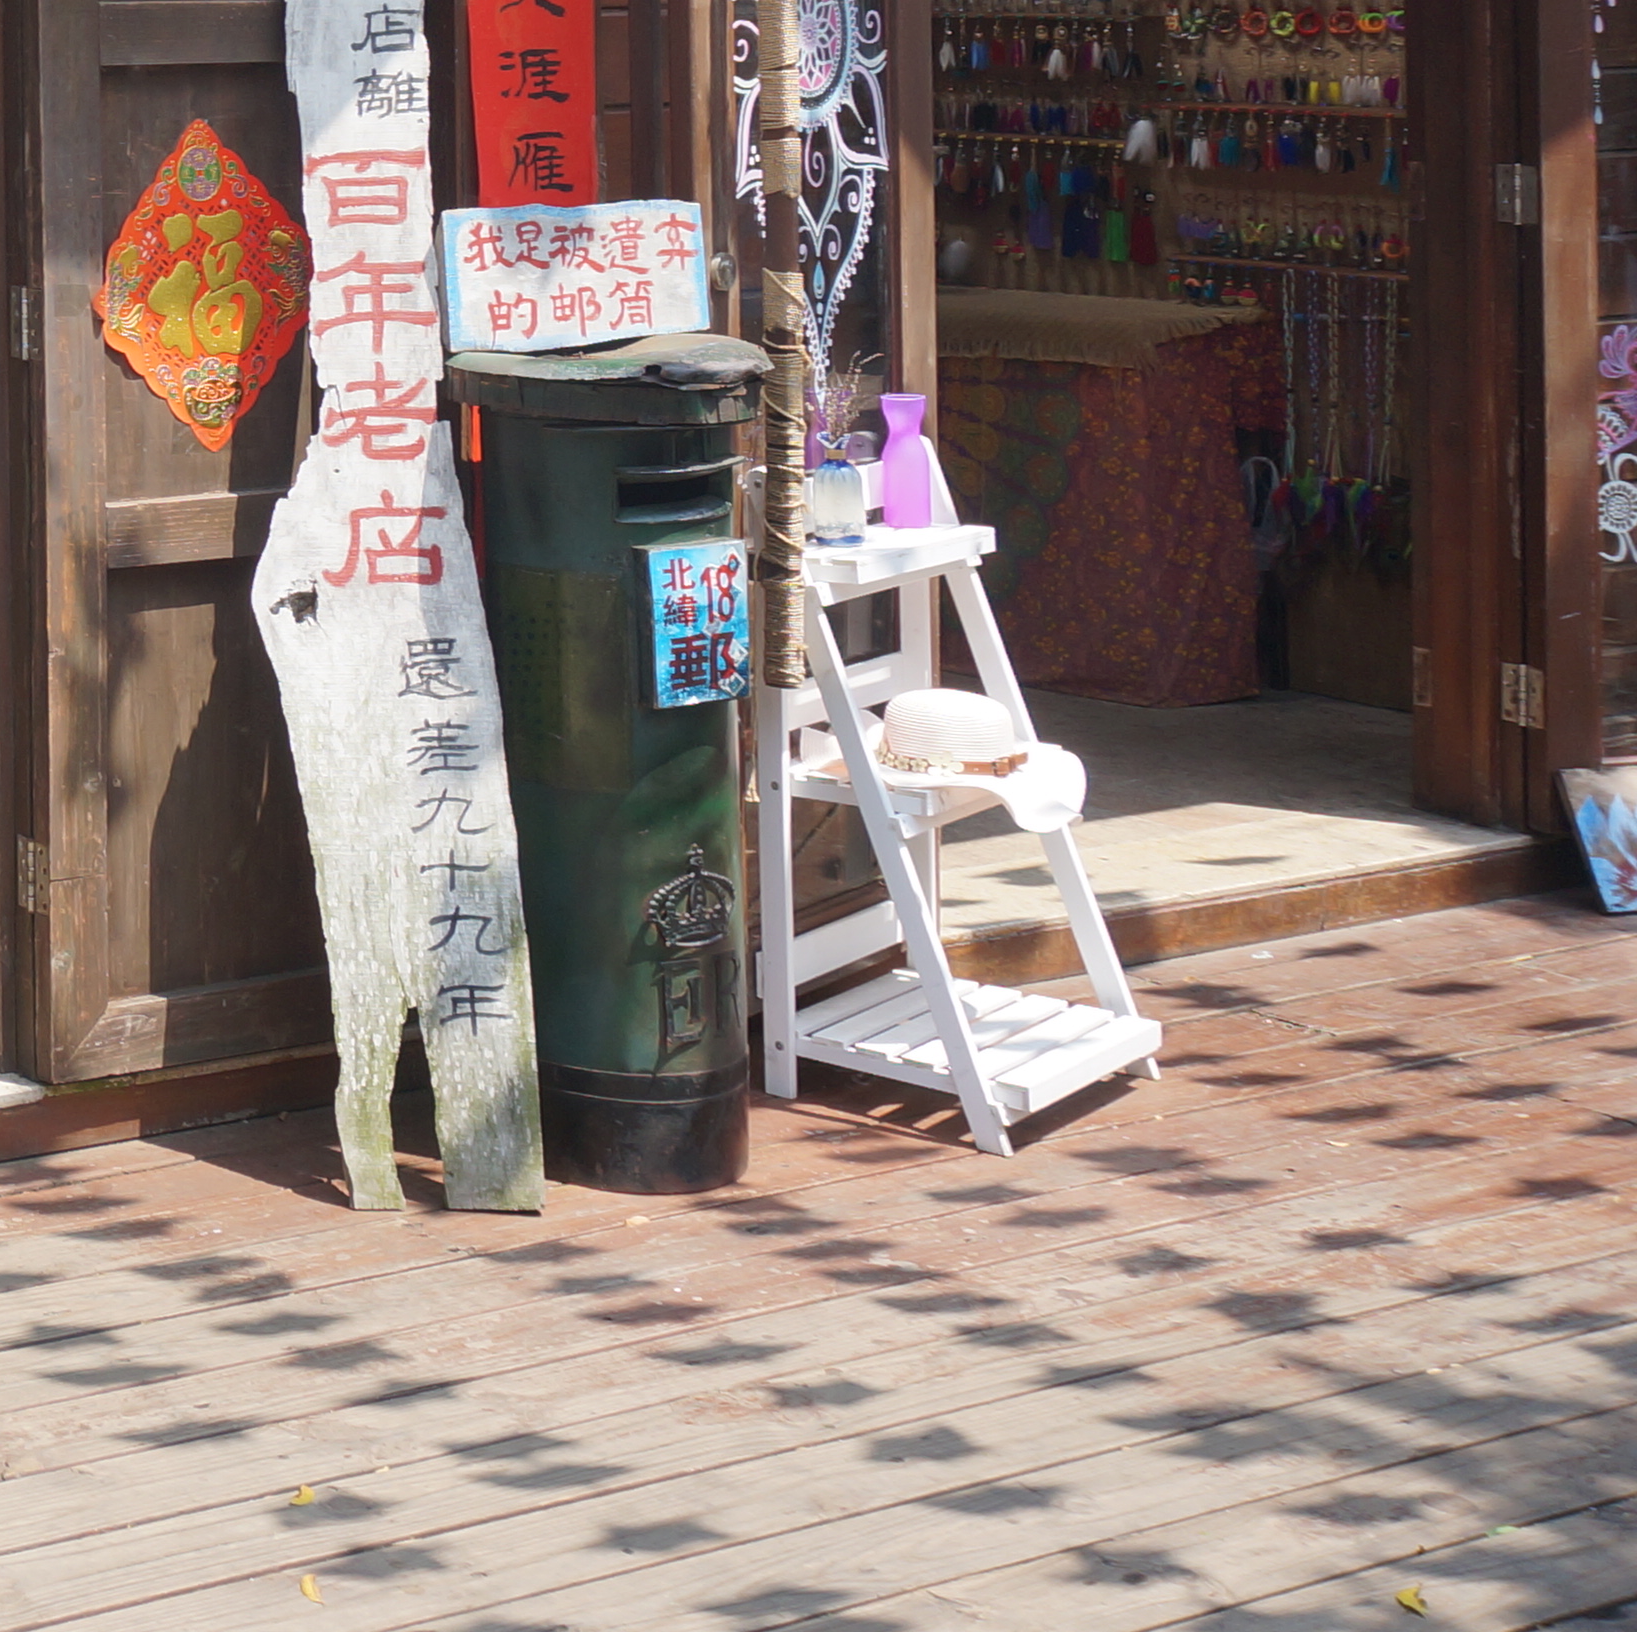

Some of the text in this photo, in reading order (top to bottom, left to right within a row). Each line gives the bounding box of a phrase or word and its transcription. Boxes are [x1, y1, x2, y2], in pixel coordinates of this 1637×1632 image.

[147, 209, 263, 359] 福
[487, 280, 654, 340] 的邮筒
[304, 149, 448, 588] 百年老店
